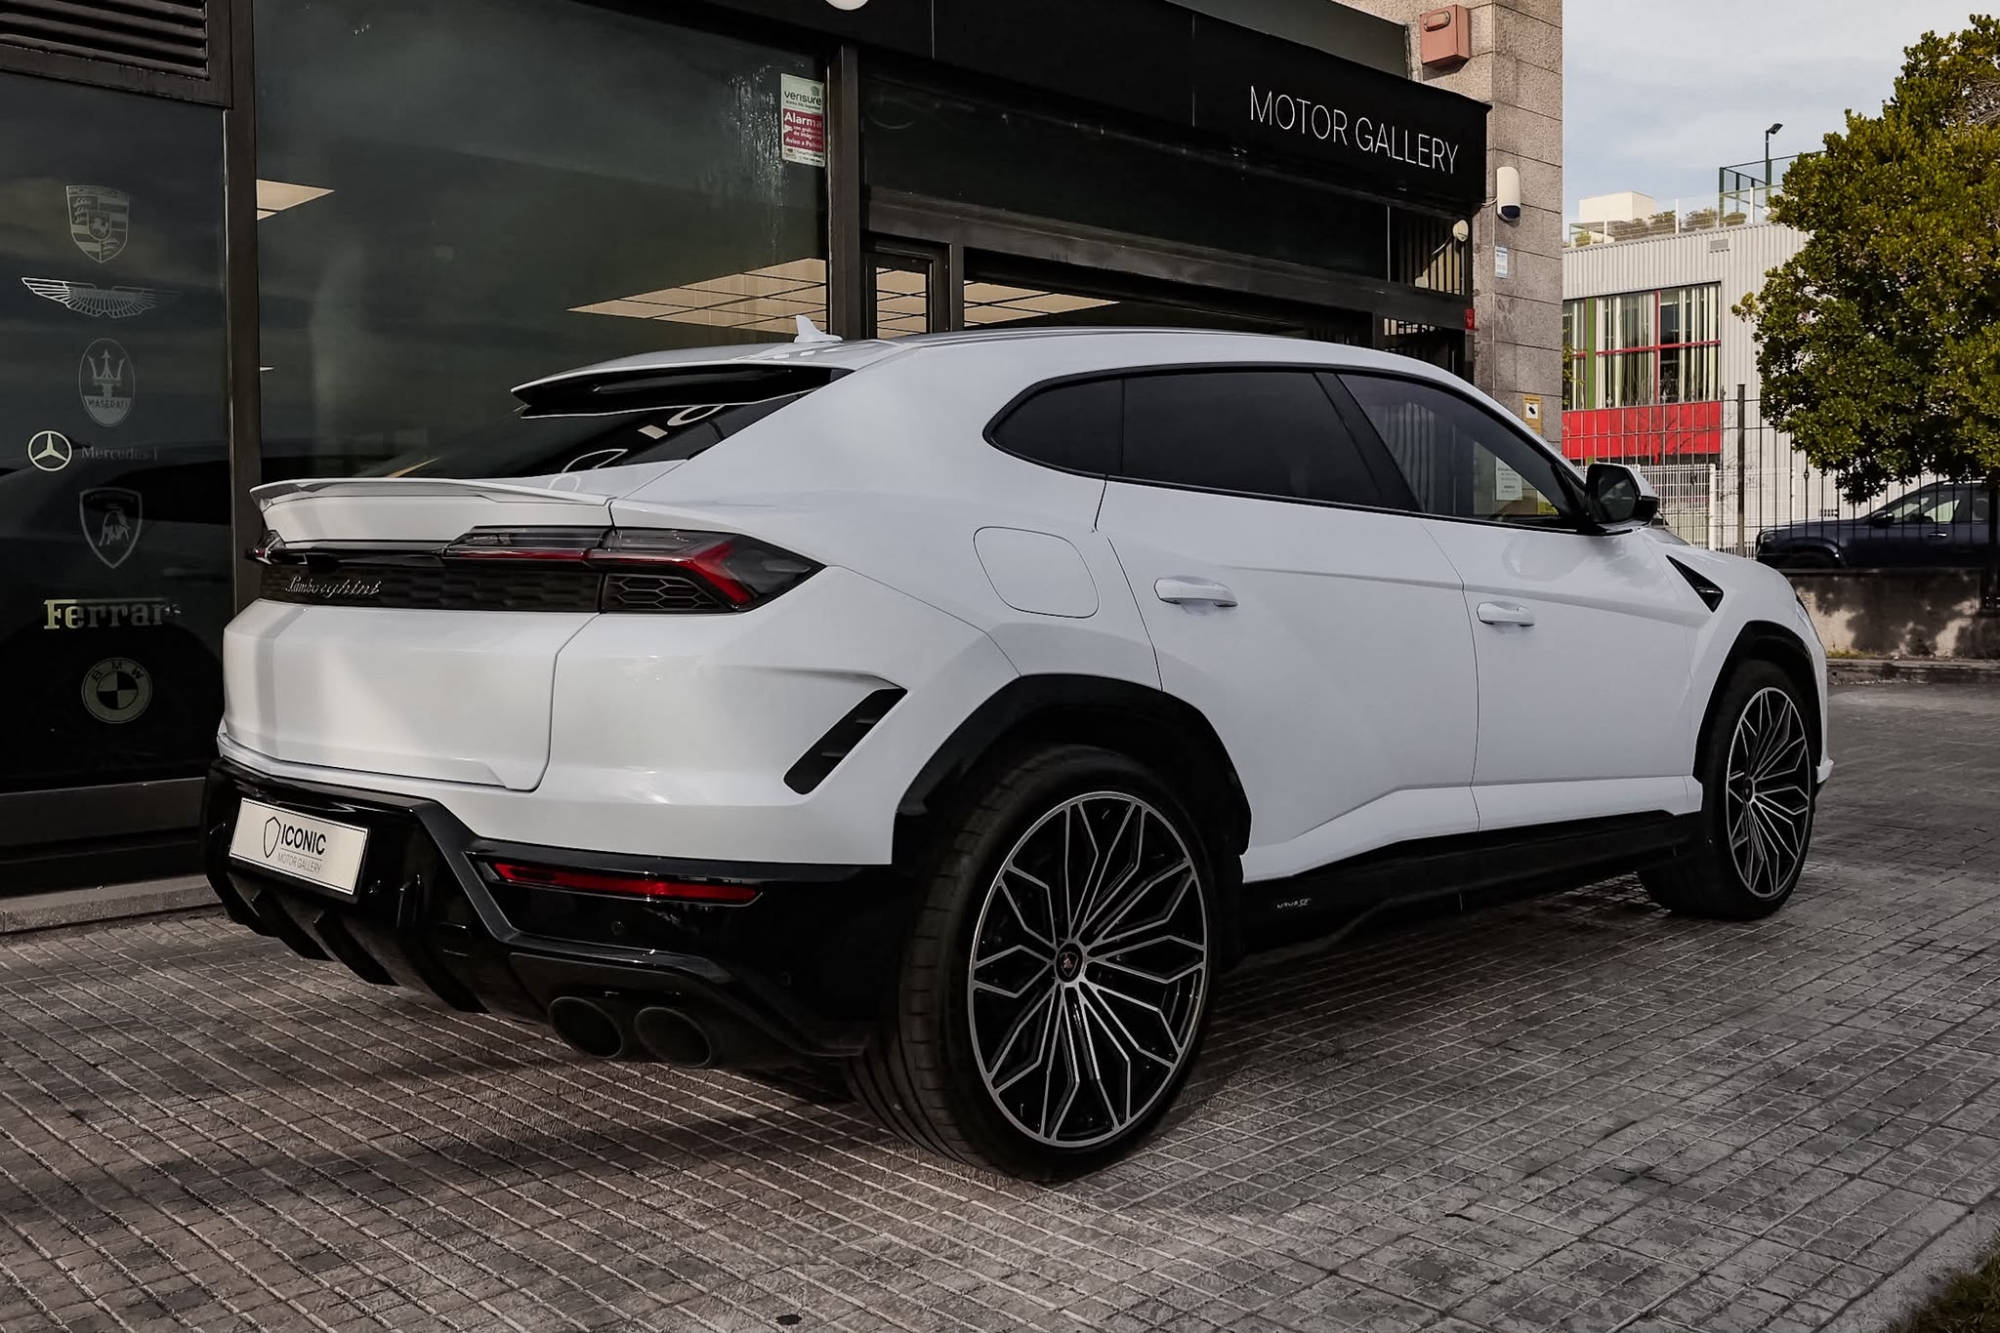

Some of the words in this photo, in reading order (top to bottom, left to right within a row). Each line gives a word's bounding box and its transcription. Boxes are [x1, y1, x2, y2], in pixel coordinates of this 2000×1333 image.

[784, 90, 822, 105] verisure
[784, 112, 822, 127] Alarma
[1250, 85, 1348, 146] MOTOR
[1355, 116, 1459, 174] GALLERY
[43, 597, 180, 630] Ferrar
[91, 661, 144, 682] BMW
[281, 823, 327, 856] ICONIC
[277, 852, 297, 868] MOTOR
[297, 858, 322, 874] GALLERY
